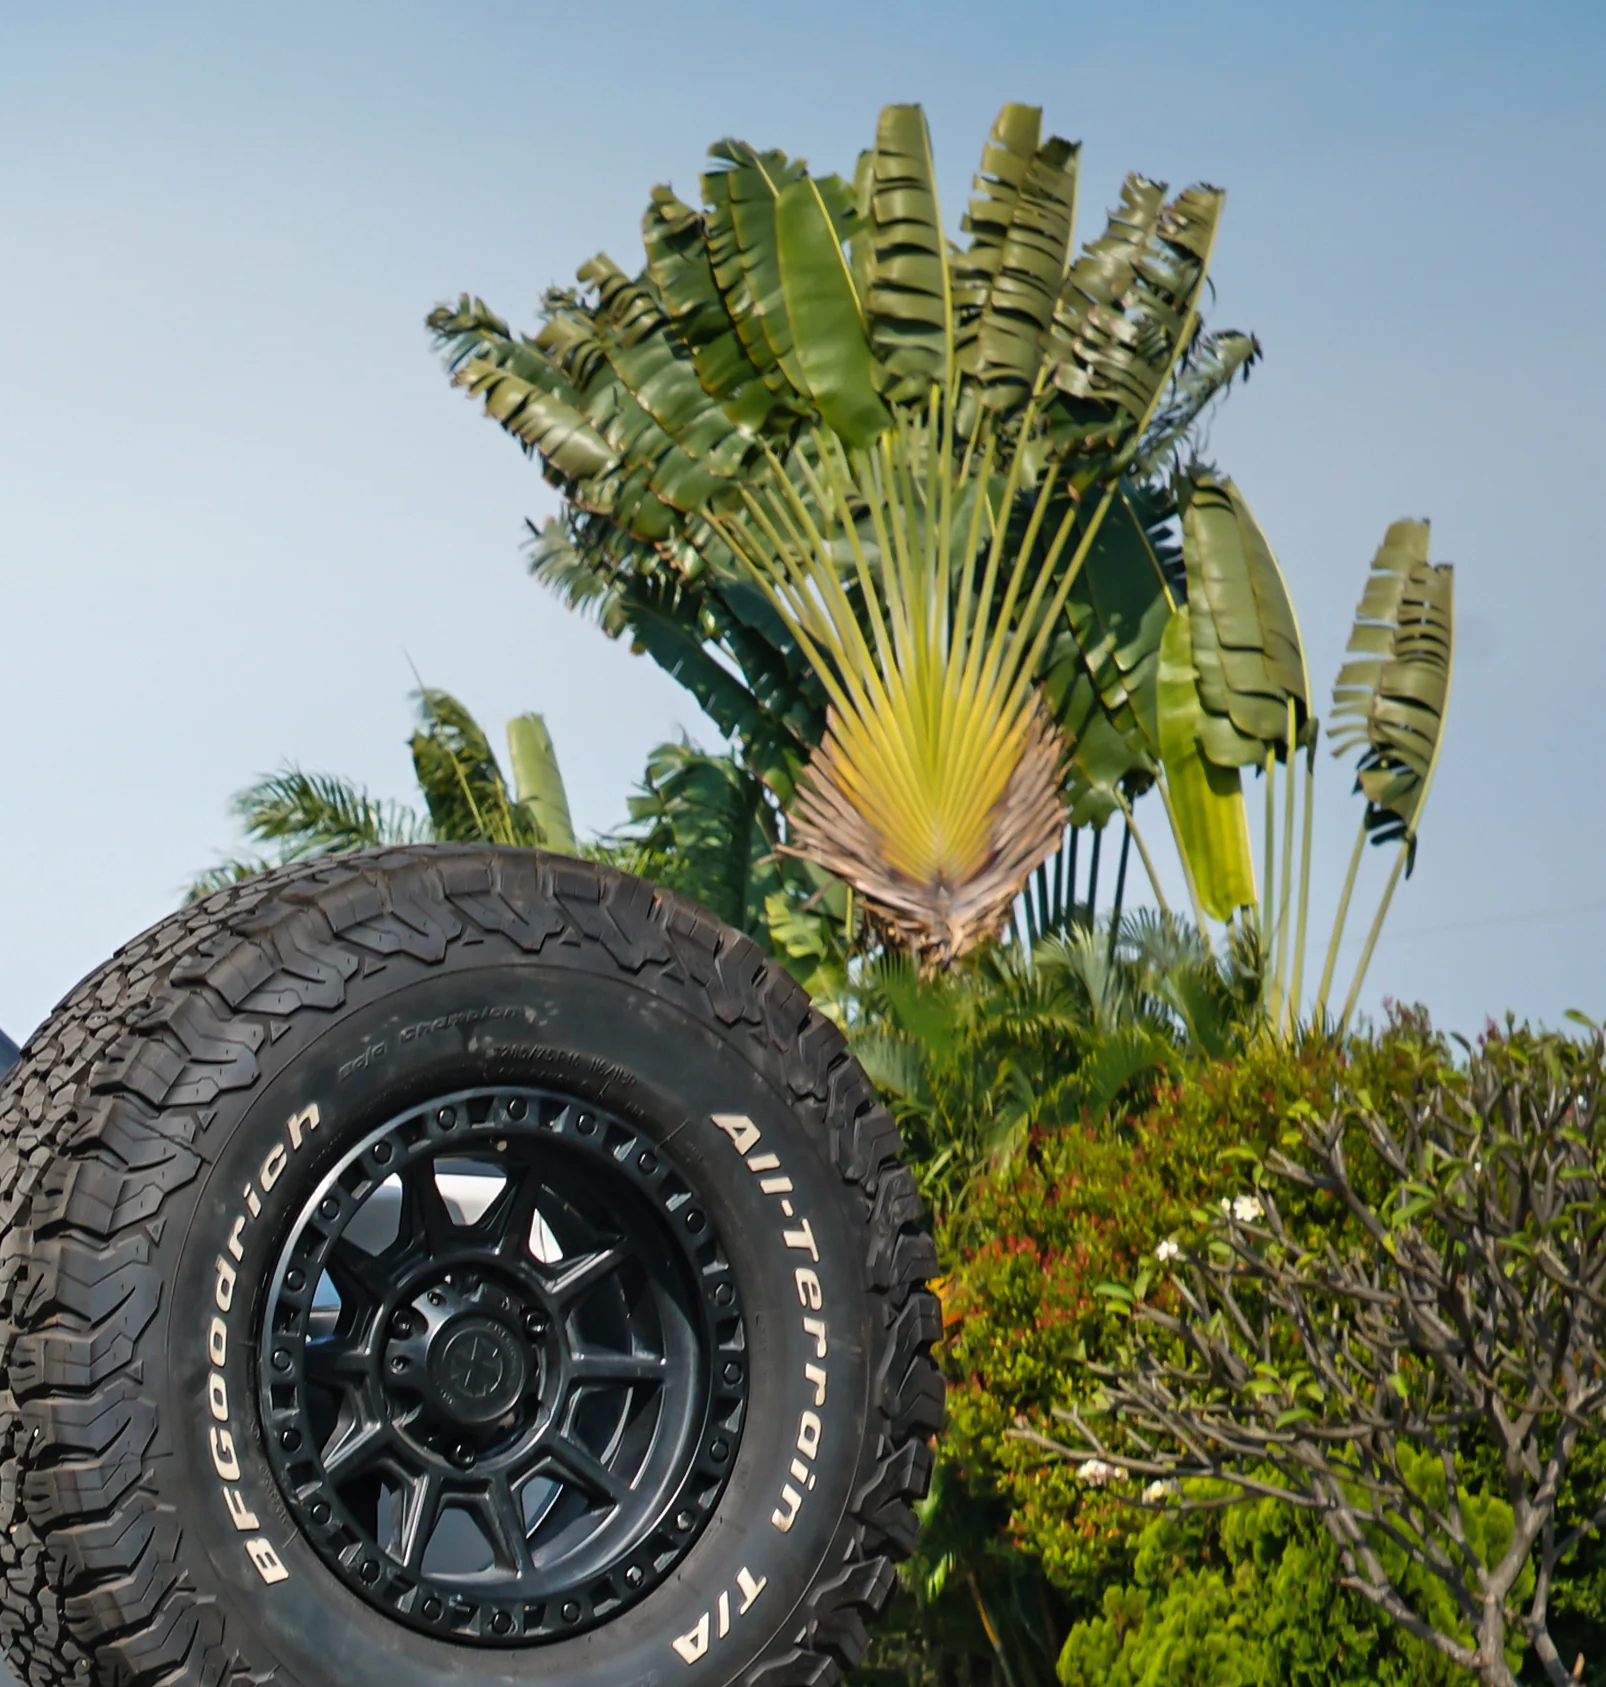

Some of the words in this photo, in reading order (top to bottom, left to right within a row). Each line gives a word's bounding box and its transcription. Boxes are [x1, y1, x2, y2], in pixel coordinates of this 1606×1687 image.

[208, 1101, 321, 1585] BFGoodrich
[710, 1112, 827, 1534] All-Terrain
[671, 1565, 768, 1665] T/A
